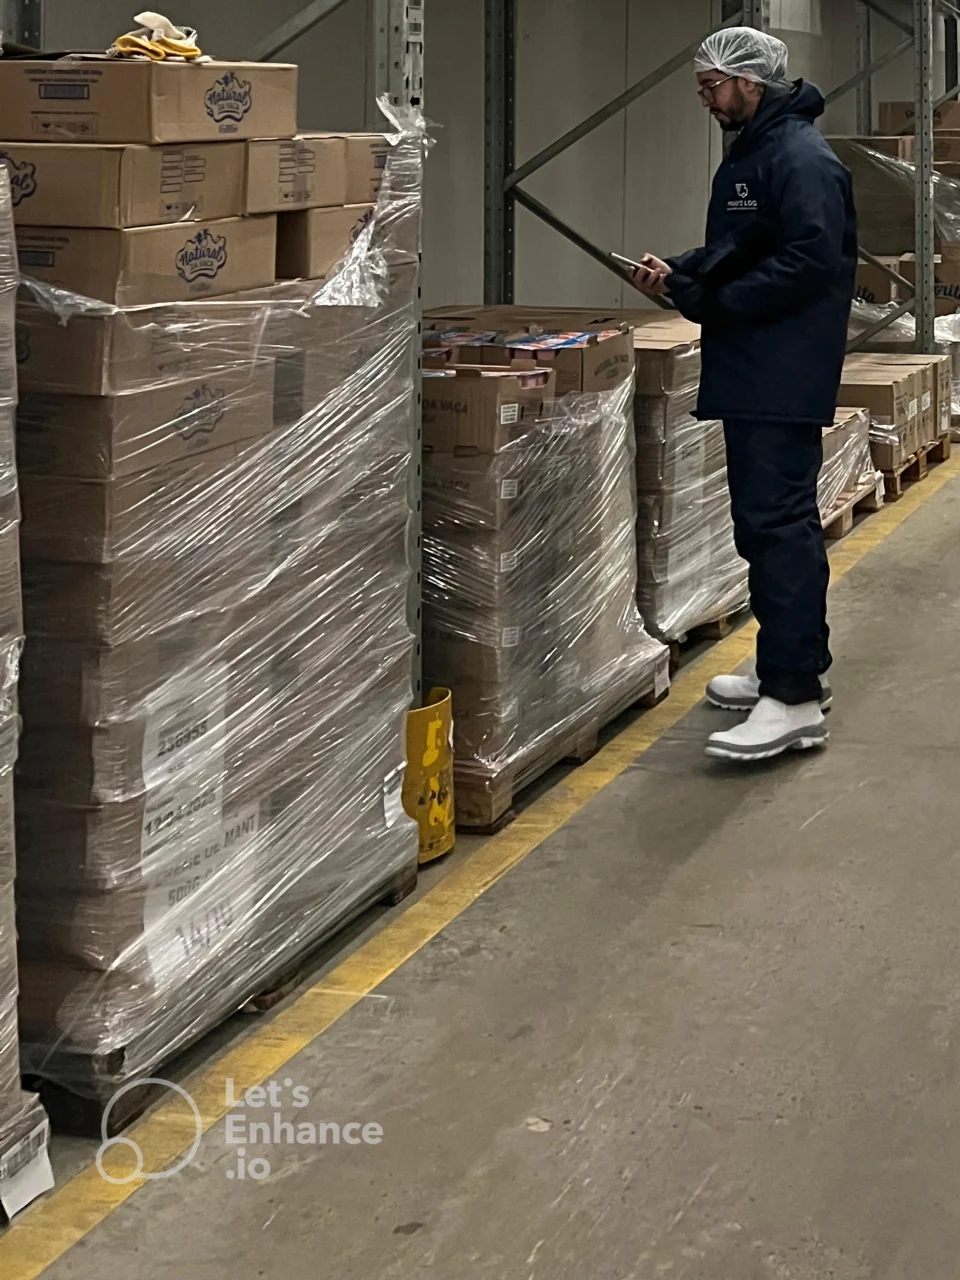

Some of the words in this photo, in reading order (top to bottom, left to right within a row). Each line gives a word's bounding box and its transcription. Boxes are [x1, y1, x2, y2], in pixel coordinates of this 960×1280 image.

[207, 86, 248, 106] Natural
[179, 245, 223, 266] Natural
[440, 400, 468, 415] VACA
